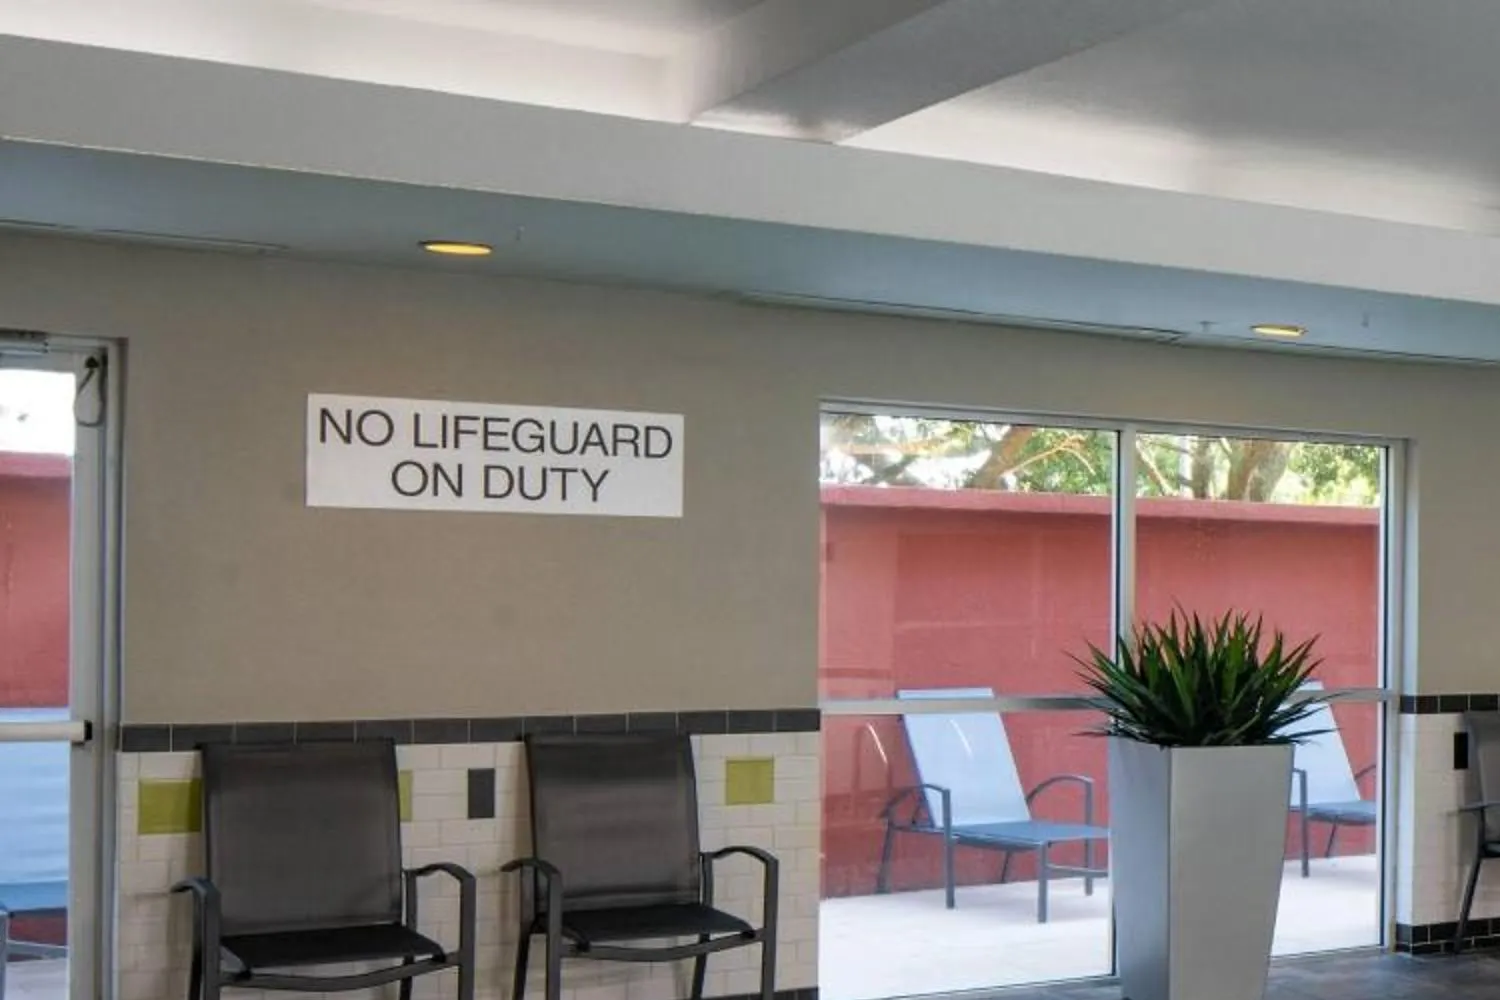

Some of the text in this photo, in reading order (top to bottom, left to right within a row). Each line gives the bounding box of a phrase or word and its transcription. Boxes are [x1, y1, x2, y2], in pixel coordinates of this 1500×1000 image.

[319, 407, 674, 459] NO LIFEGUARD
[391, 460, 610, 503] ON DUTY
